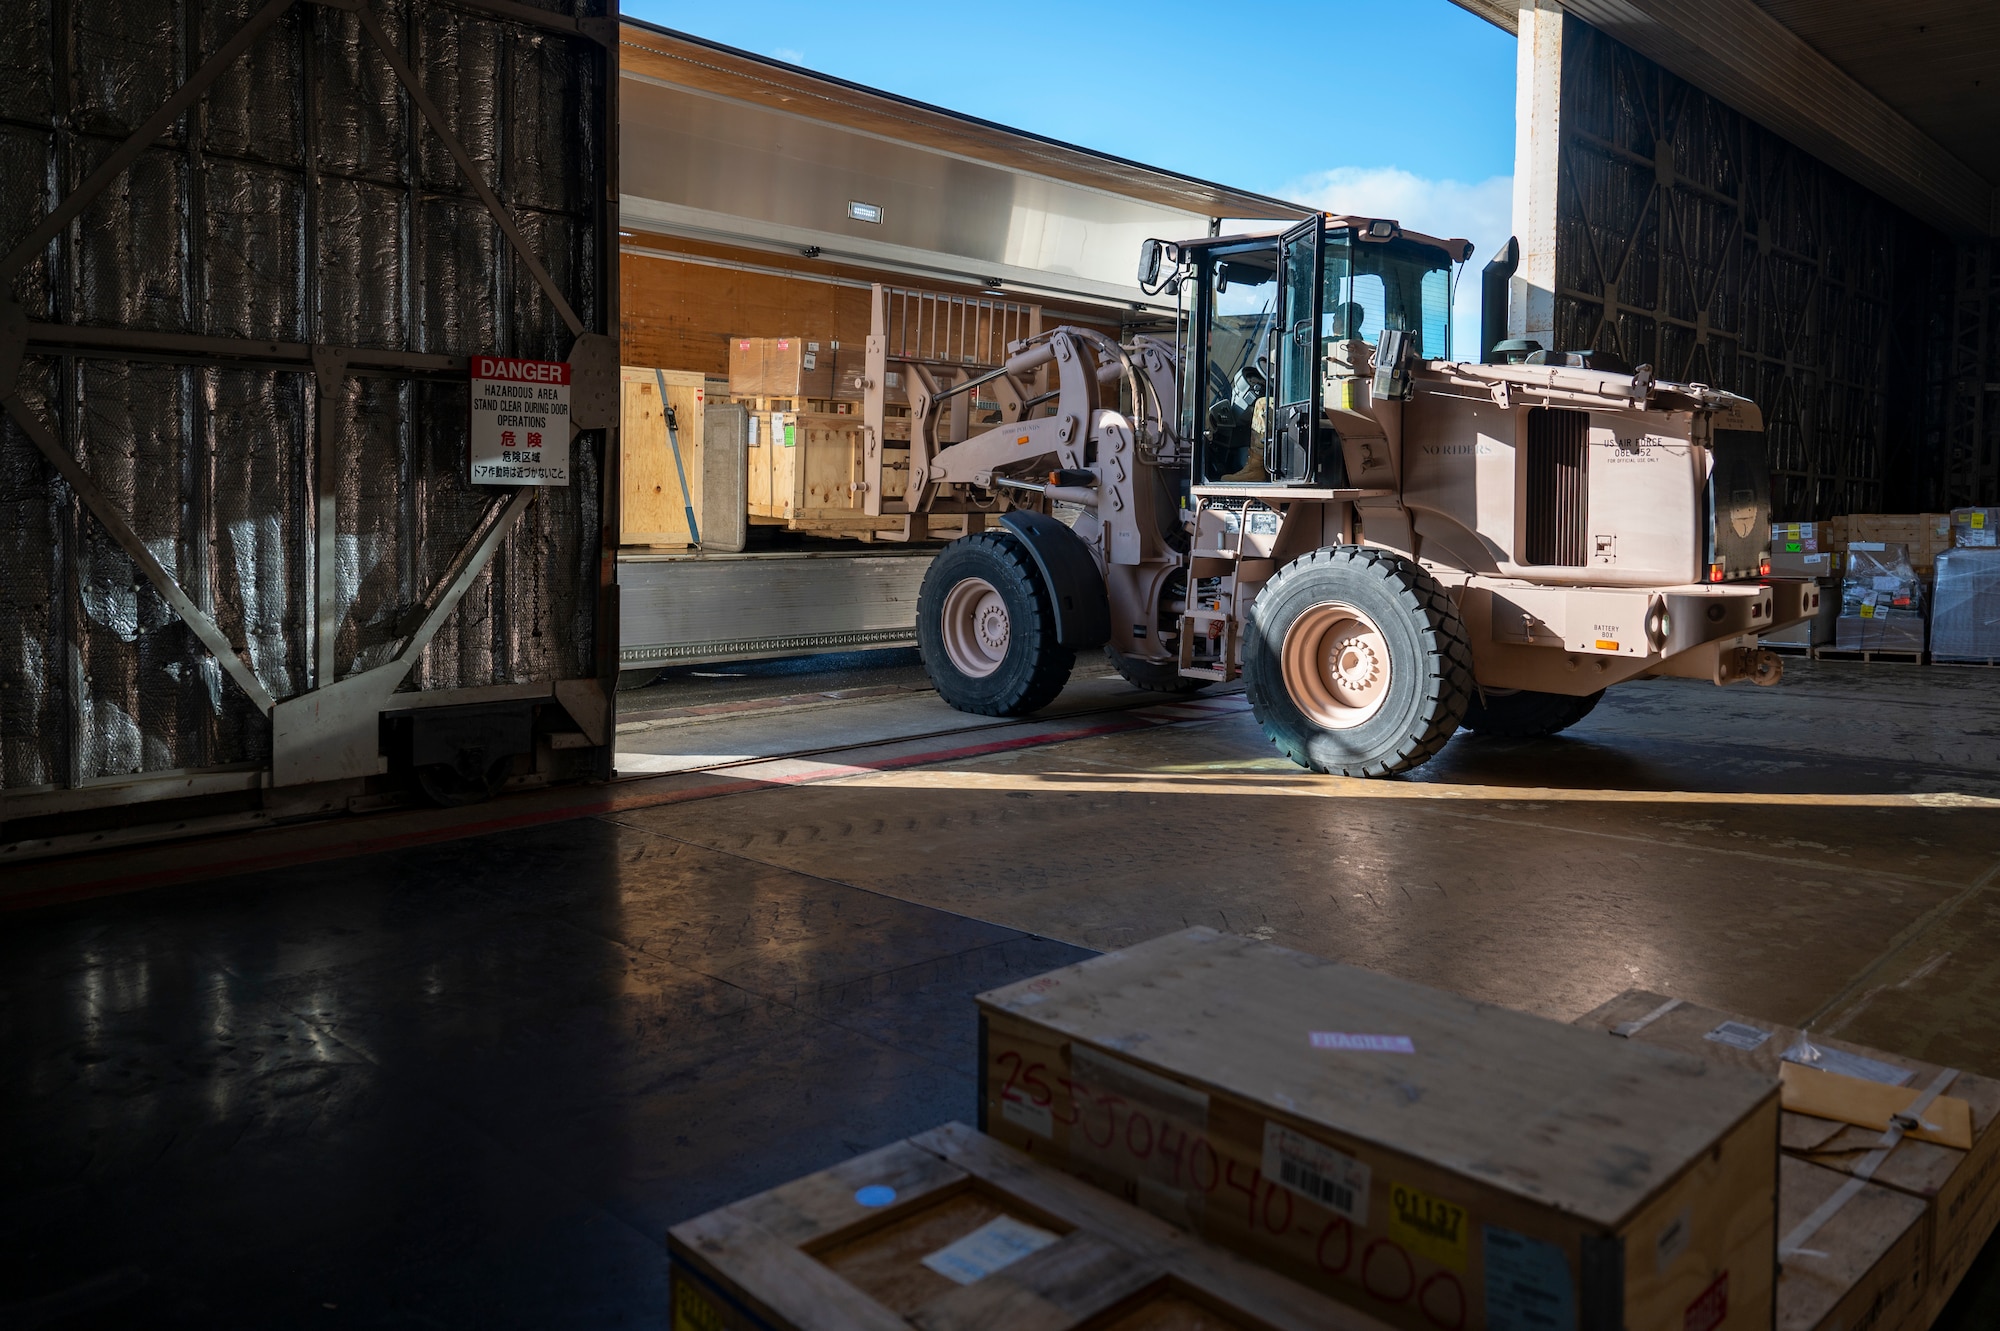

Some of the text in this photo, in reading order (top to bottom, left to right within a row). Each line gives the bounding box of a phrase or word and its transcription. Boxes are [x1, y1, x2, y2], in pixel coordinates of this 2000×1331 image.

[480, 359, 562, 382] DANGER
[484, 384, 558, 400] HAZARDOUS AREA
[474, 399, 568, 416] STAND CLEAR DURING DOOR
[497, 414, 546, 428] OPERATIONS
[1016, 424, 1040, 433] POUNDS
[501, 430, 543, 448] 危険
[1604, 437, 1663, 447] US AIR FORCE
[502, 451, 541, 463] 危険区域
[1422, 445, 1492, 455] NO RIDERS
[1593, 624, 1620, 632] BATTERY
[1312, 1033, 1393, 1051] FRAGILE
